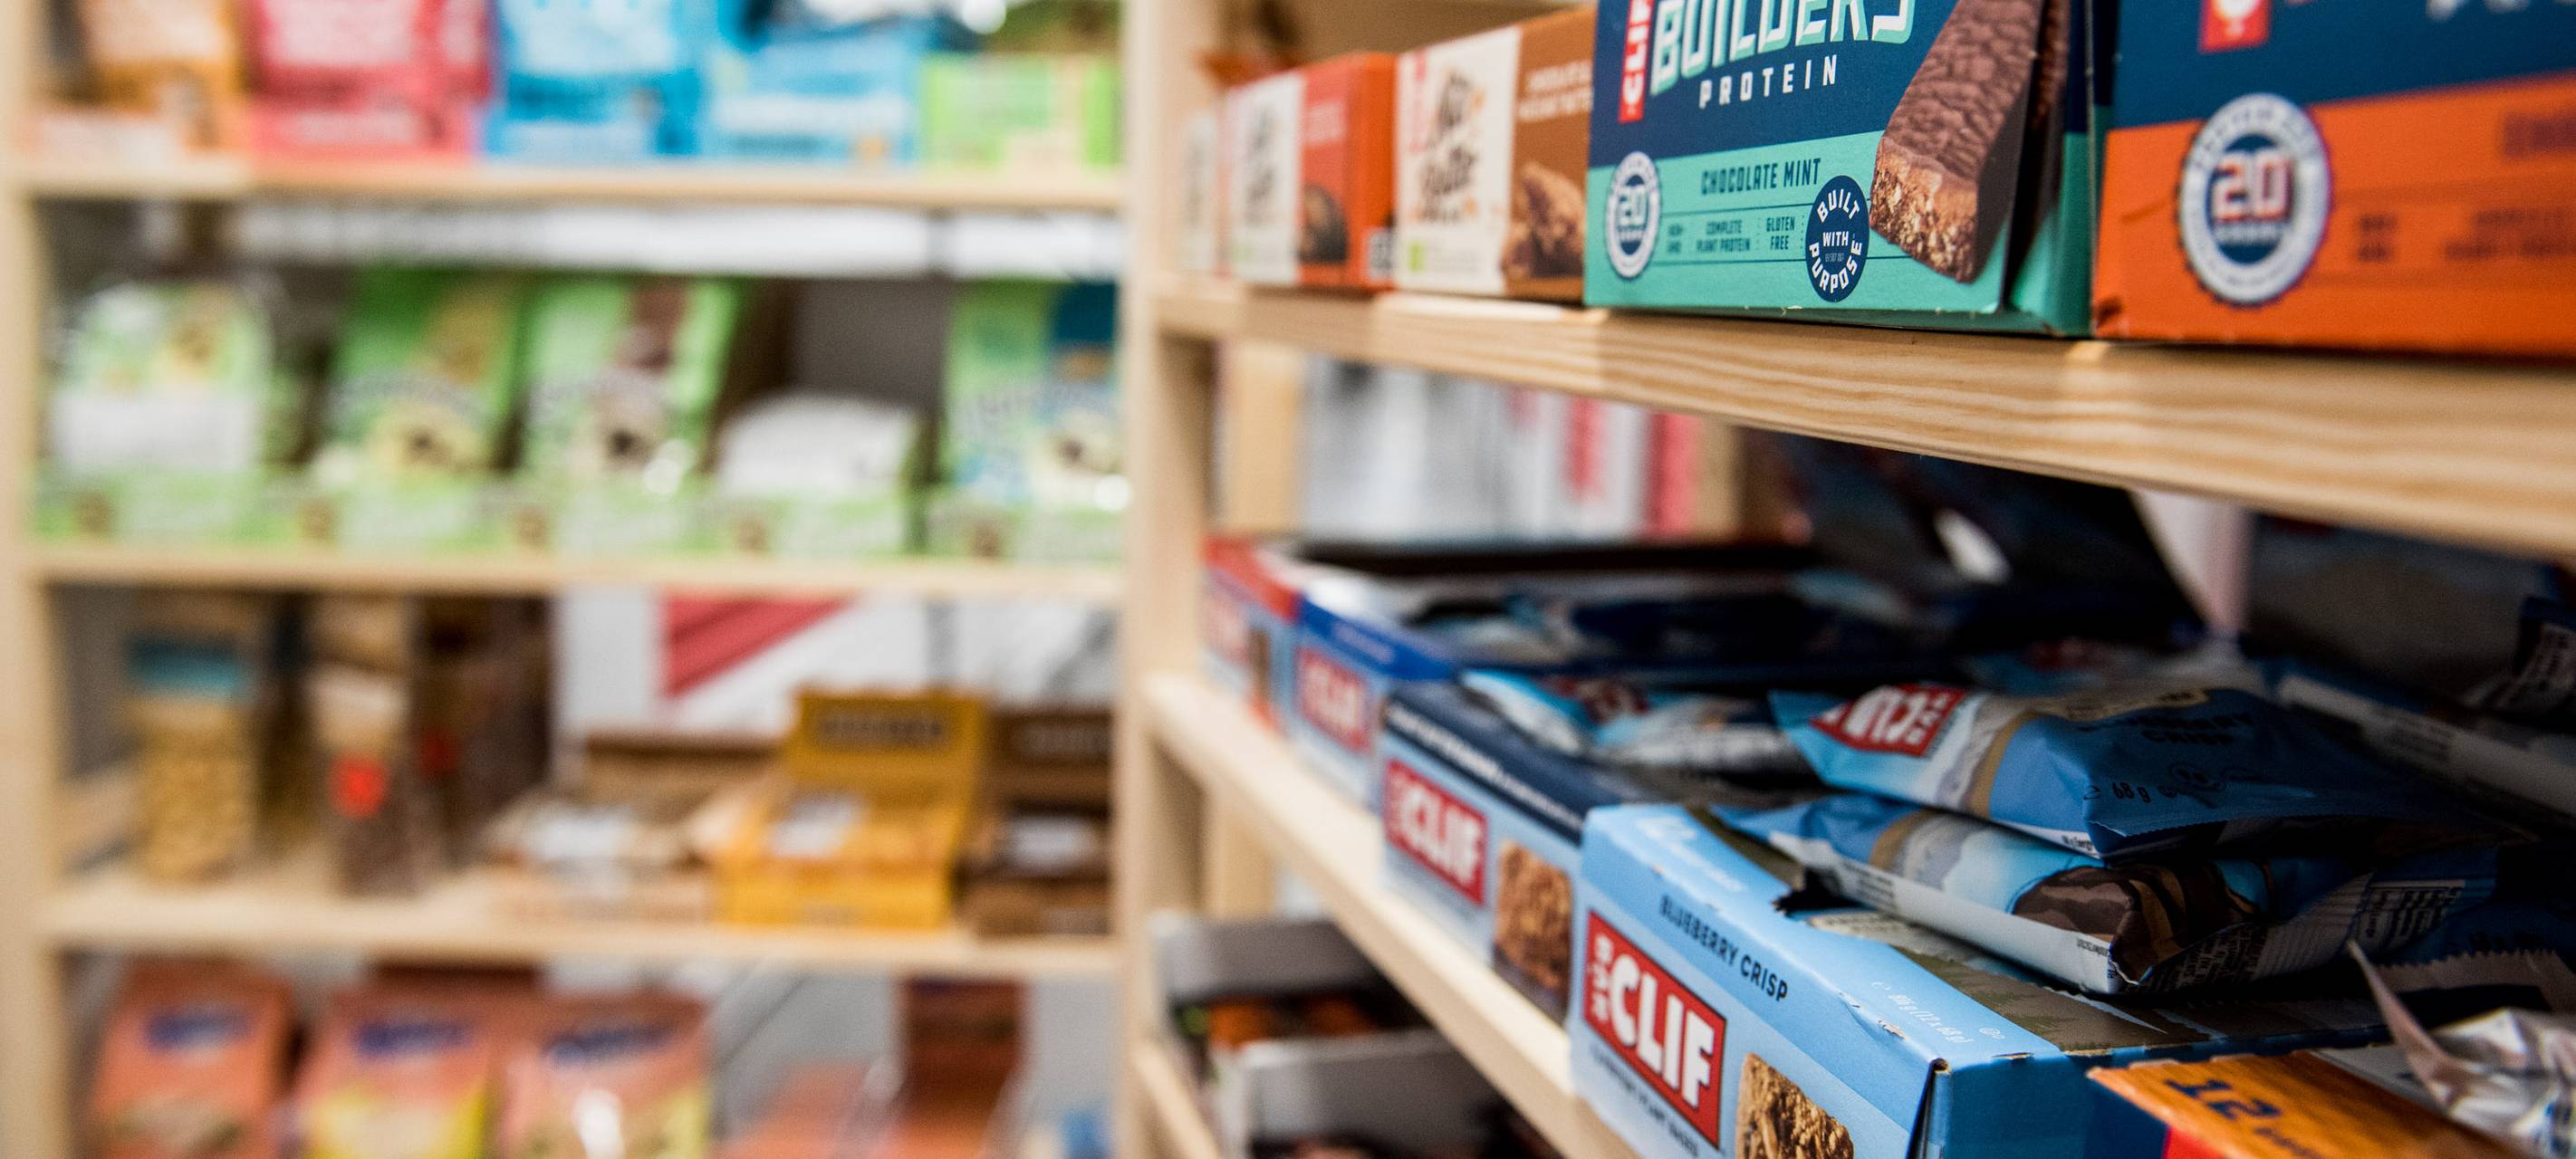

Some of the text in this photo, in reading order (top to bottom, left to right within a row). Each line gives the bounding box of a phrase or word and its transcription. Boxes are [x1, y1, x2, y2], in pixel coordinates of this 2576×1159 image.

[1698, 54, 1838, 110] PROTEIN
[1701, 158, 1821, 196] CHOCOLATE MINT
[2210, 148, 2293, 225] 20
[1766, 216, 1796, 232] GLUTEN
[1816, 188, 1860, 224] BUILT
[1770, 235, 1791, 251] FREE
[1822, 231, 1850, 247] WITH
[1809, 239, 1862, 294] PURPOSE
[2111, 782, 2135, 799] 68
[1660, 895, 1789, 1002] BLUEBERRY CRISP
[1609, 953, 1716, 1112] CLIF
